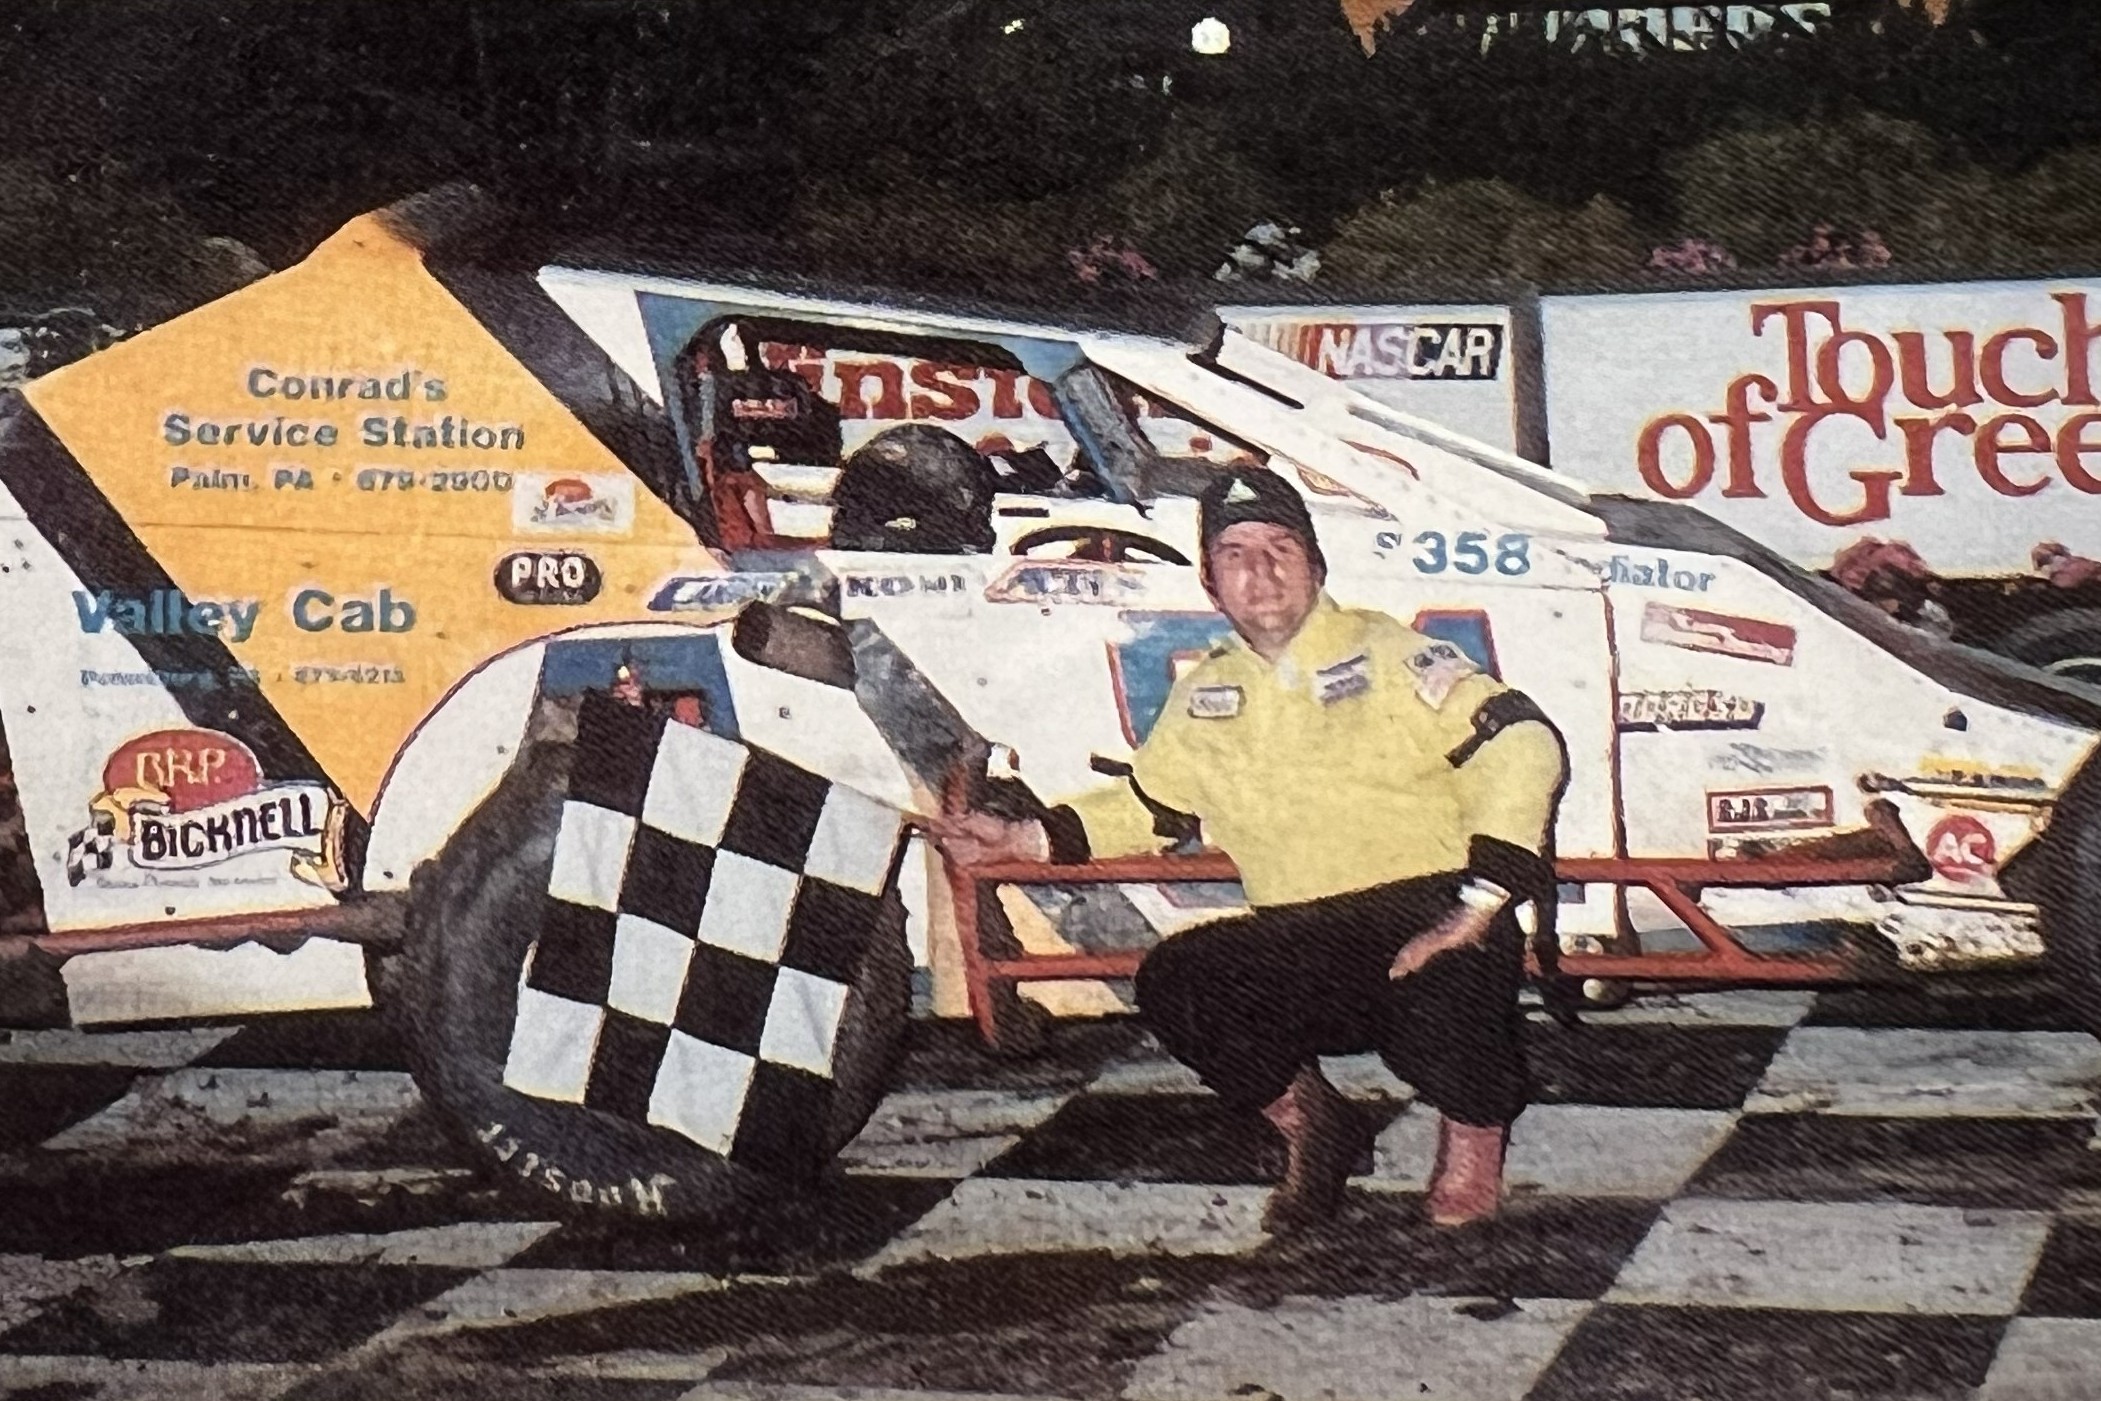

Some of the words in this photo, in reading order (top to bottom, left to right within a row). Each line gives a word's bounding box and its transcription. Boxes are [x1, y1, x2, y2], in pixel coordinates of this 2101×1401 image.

[1318, 325, 1497, 378] NASCAR
[1750, 292, 2101, 410] Touch
[248, 367, 448, 401] Conrad's
[164, 413, 339, 447] Service
[362, 414, 526, 451] Station
[1637, 373, 1778, 499] of
[1780, 405, 2101, 526] Gree
[511, 555, 587, 590] PRO
[1411, 531, 1532, 576] 358
[72, 588, 259, 643] Valley
[292, 588, 416, 633] Cab
